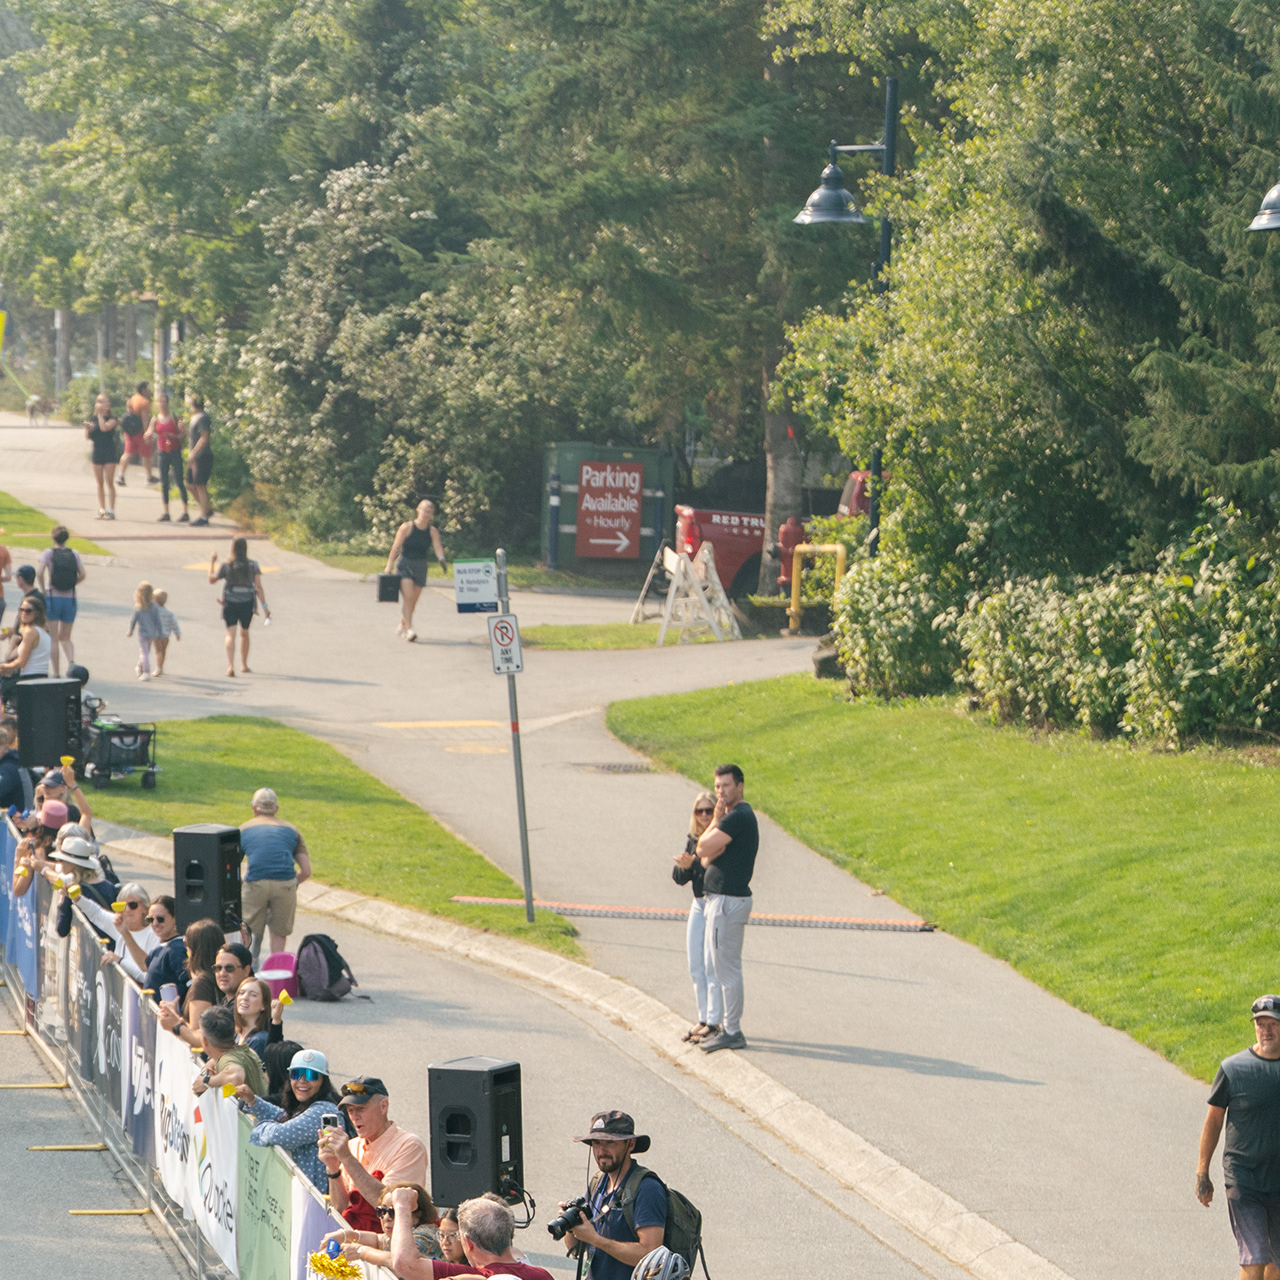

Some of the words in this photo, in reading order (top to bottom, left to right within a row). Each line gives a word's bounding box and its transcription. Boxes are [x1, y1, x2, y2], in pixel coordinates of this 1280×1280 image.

[582, 464, 640, 494] Parking
[581, 492, 639, 513] Available
[593, 514, 631, 531] Hourly
[712, 513, 739, 527] RED
[742, 515, 766, 528] TRU
[501, 648, 512, 656] ANY
[501, 656, 513, 664] TIME
